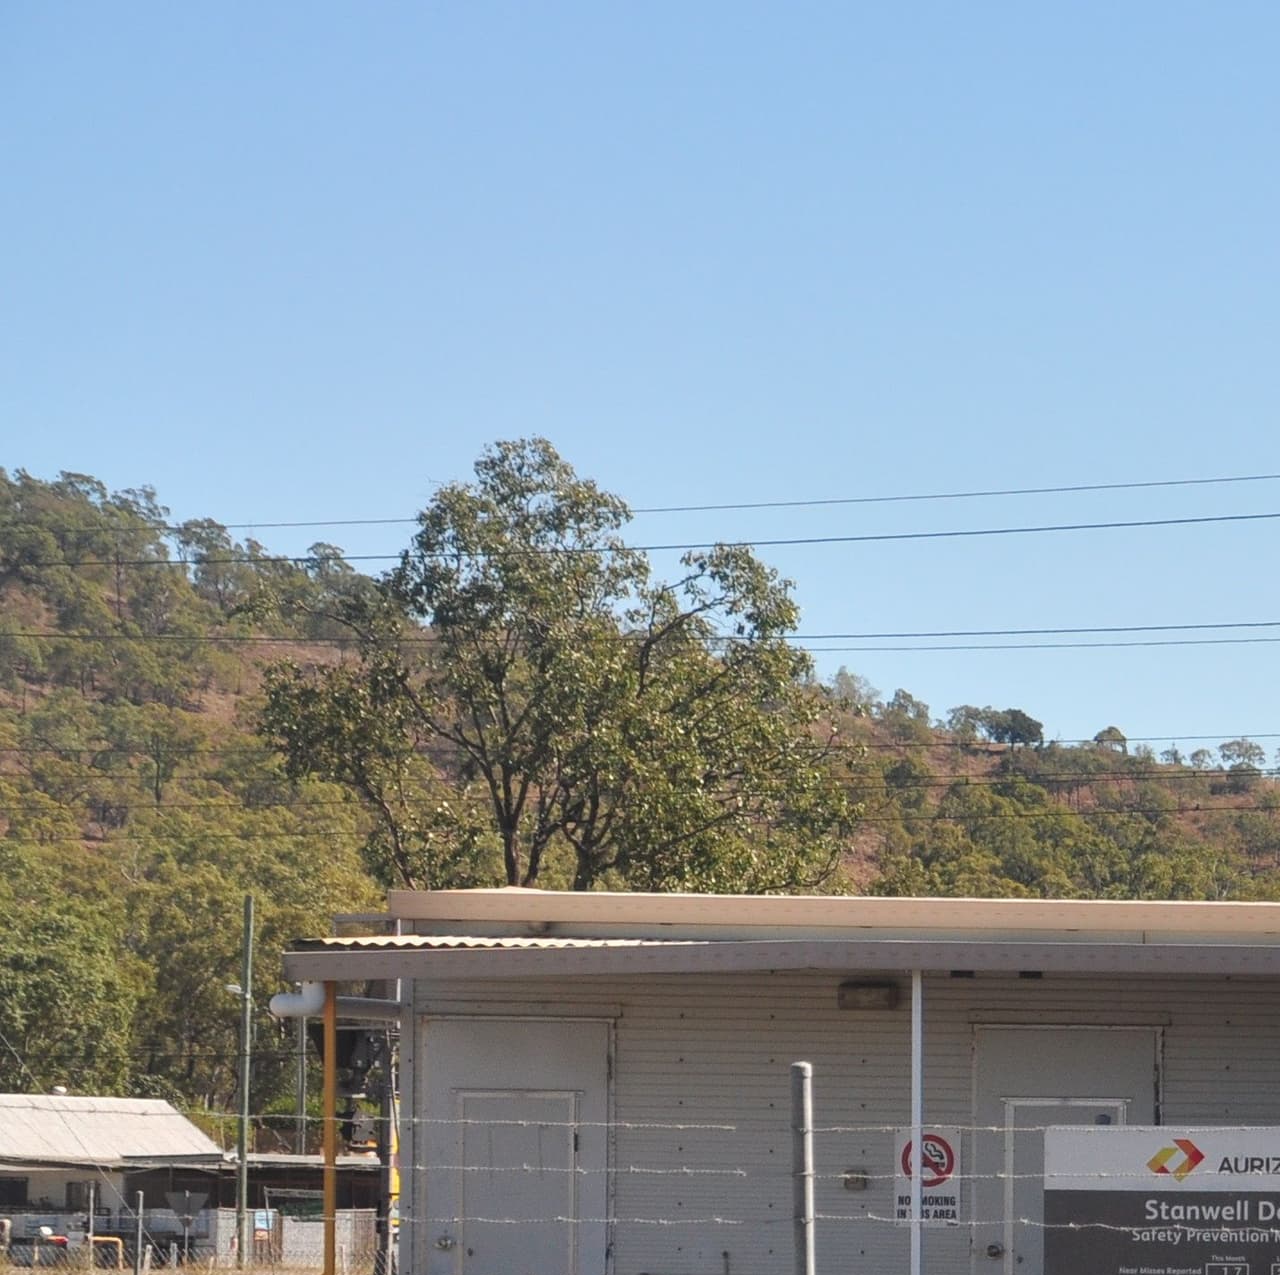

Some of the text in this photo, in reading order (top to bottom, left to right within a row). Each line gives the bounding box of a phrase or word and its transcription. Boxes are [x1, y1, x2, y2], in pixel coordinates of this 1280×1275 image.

[898, 1196, 956, 1206] NO MOKING
[897, 1209, 906, 1219] IN
[933, 1209, 957, 1219] AREA
[1144, 1200, 1249, 1221] Stanwell
[1132, 1229, 1181, 1245] Safety
[1186, 1229, 1269, 1242] Prevention
[1166, 1267, 1202, 1275] Reported
